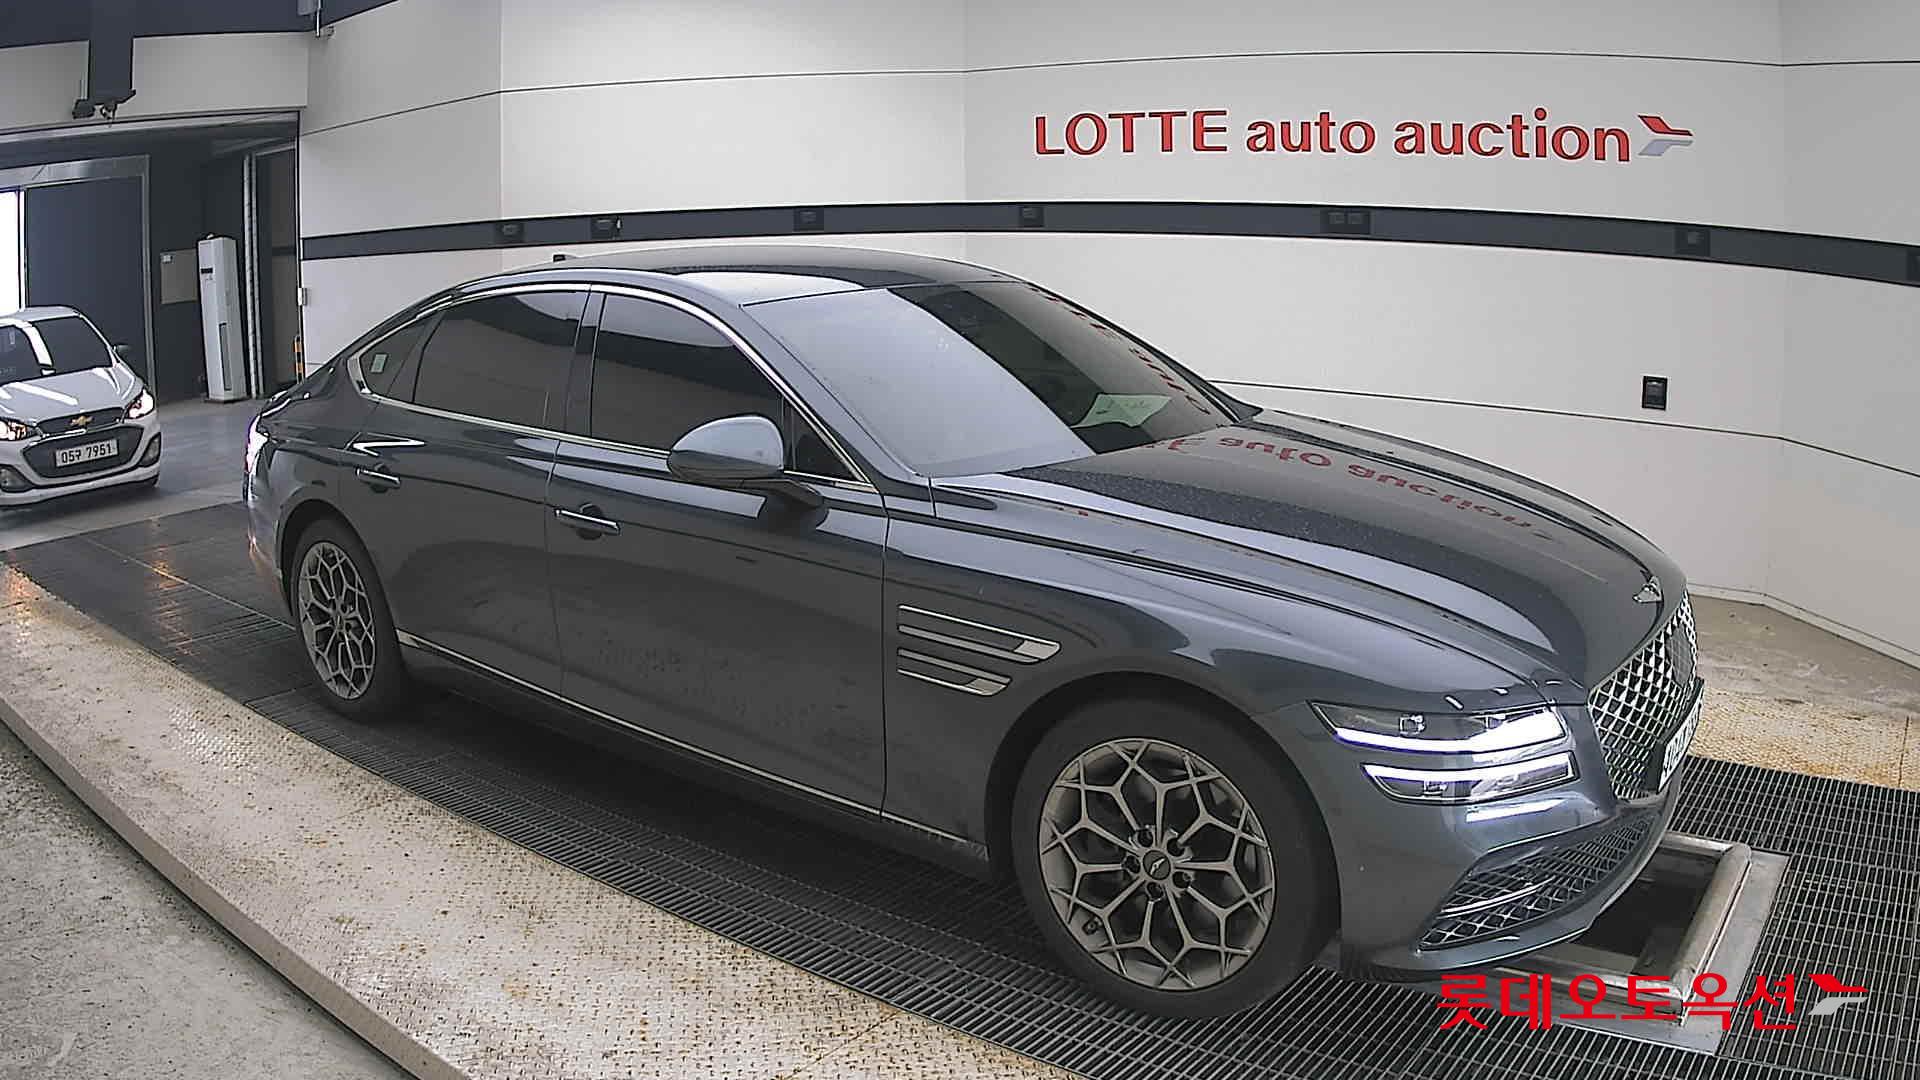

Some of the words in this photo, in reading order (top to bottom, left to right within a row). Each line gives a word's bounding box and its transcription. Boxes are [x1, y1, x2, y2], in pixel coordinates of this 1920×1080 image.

[1035, 110, 1227, 156] LOTTE
[1246, 112, 1376, 155] auto
[1394, 107, 1632, 163] auction
[86, 444, 111, 458] 7951
